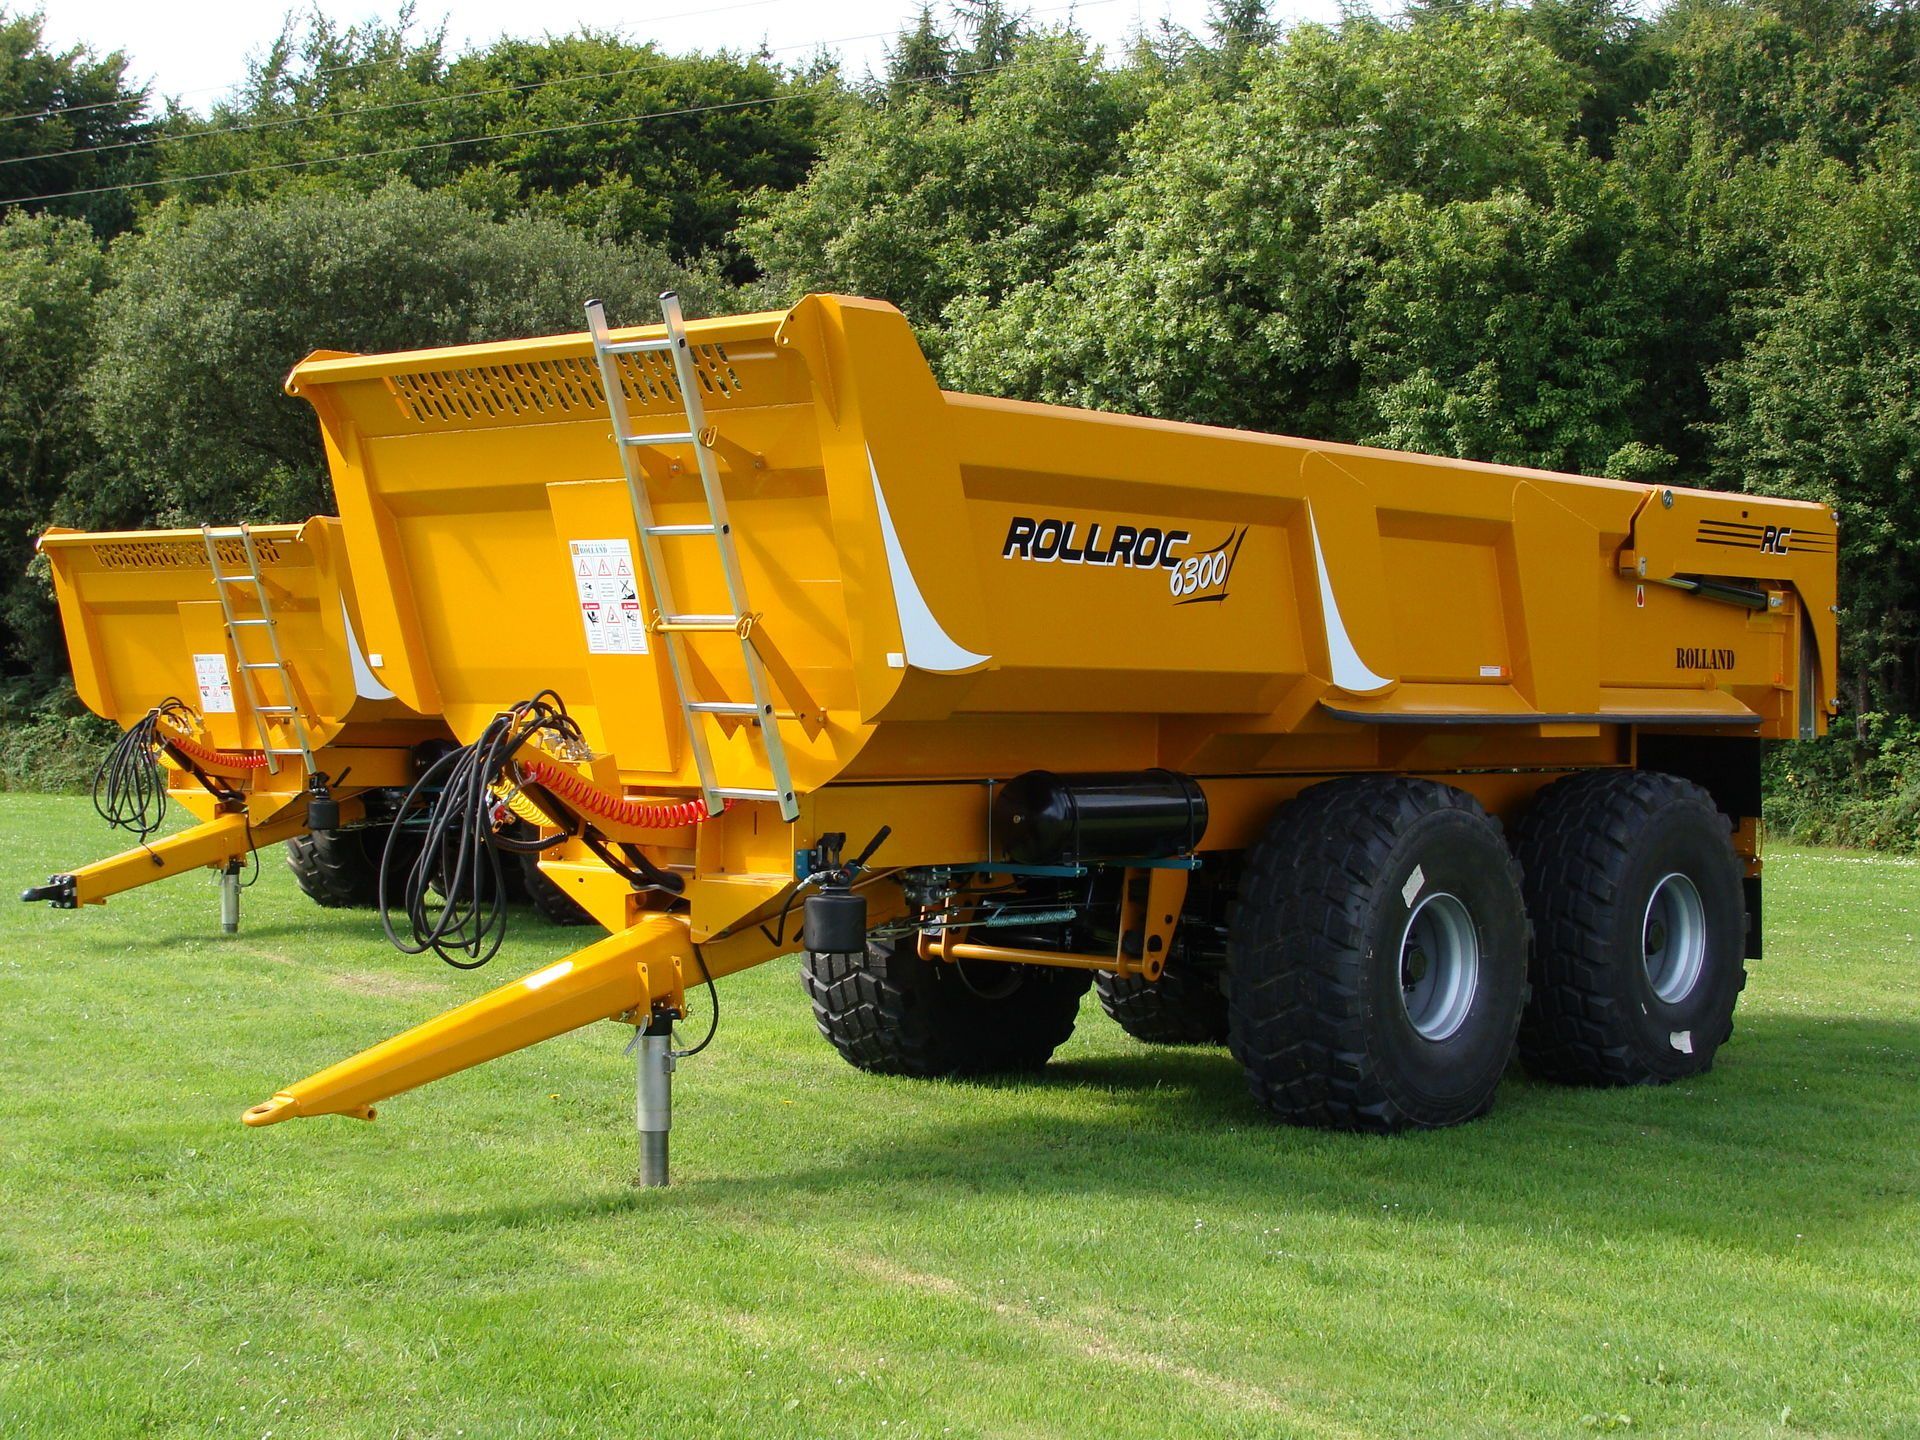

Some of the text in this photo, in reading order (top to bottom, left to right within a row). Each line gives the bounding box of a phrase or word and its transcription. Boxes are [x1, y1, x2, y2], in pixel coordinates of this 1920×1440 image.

[1002, 517, 1191, 570] ROLLROC
[1760, 525, 1792, 555] RC
[1169, 550, 1227, 597] 6300
[1675, 647, 1735, 670] ROLLAND
